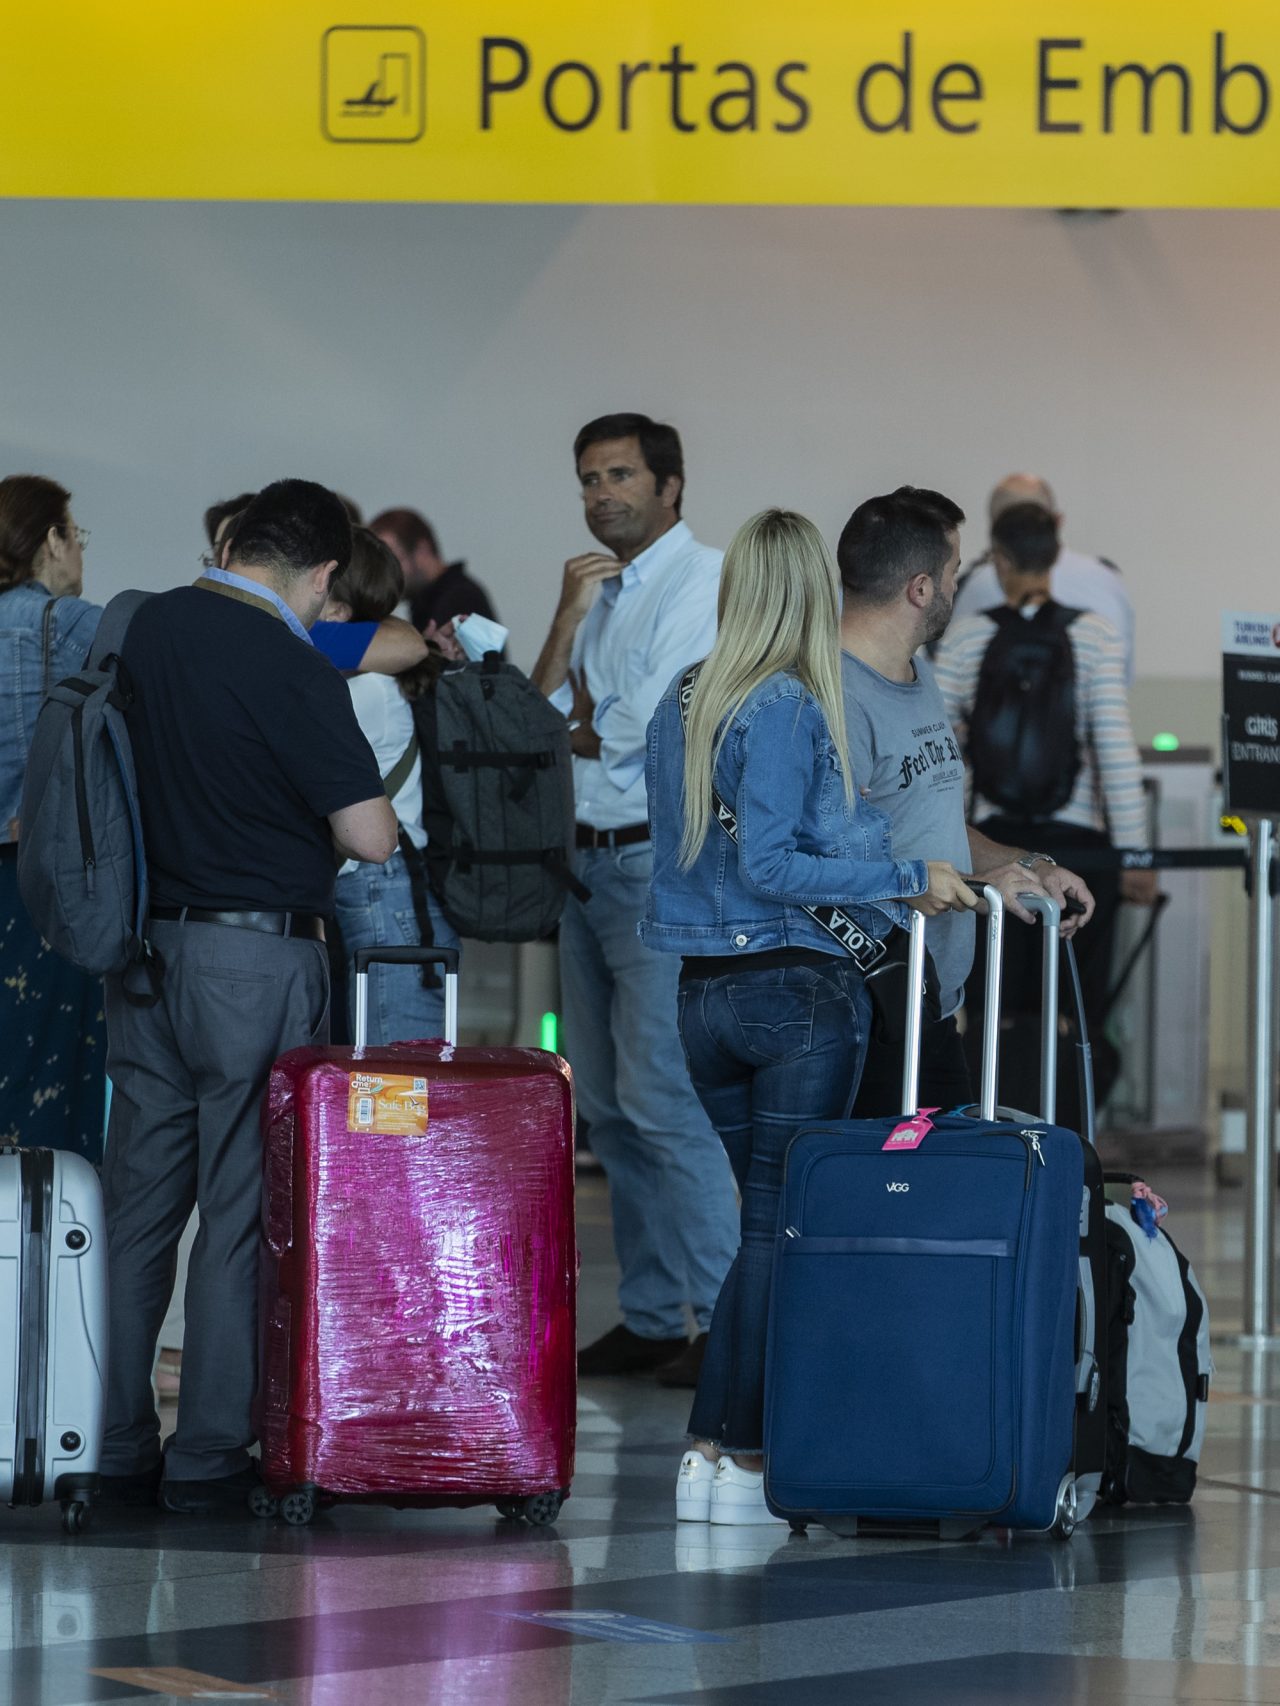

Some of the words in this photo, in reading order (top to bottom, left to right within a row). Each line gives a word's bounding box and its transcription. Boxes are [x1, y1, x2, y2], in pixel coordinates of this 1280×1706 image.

[479, 36, 812, 134] Portas
[855, 31, 985, 134] de
[1234, 620, 1271, 634] TURKISH
[911, 725, 933, 738] SUMMER
[897, 745, 931, 792] Feel
[924, 739, 946, 769] The
[356, 1073, 383, 1083] Return
